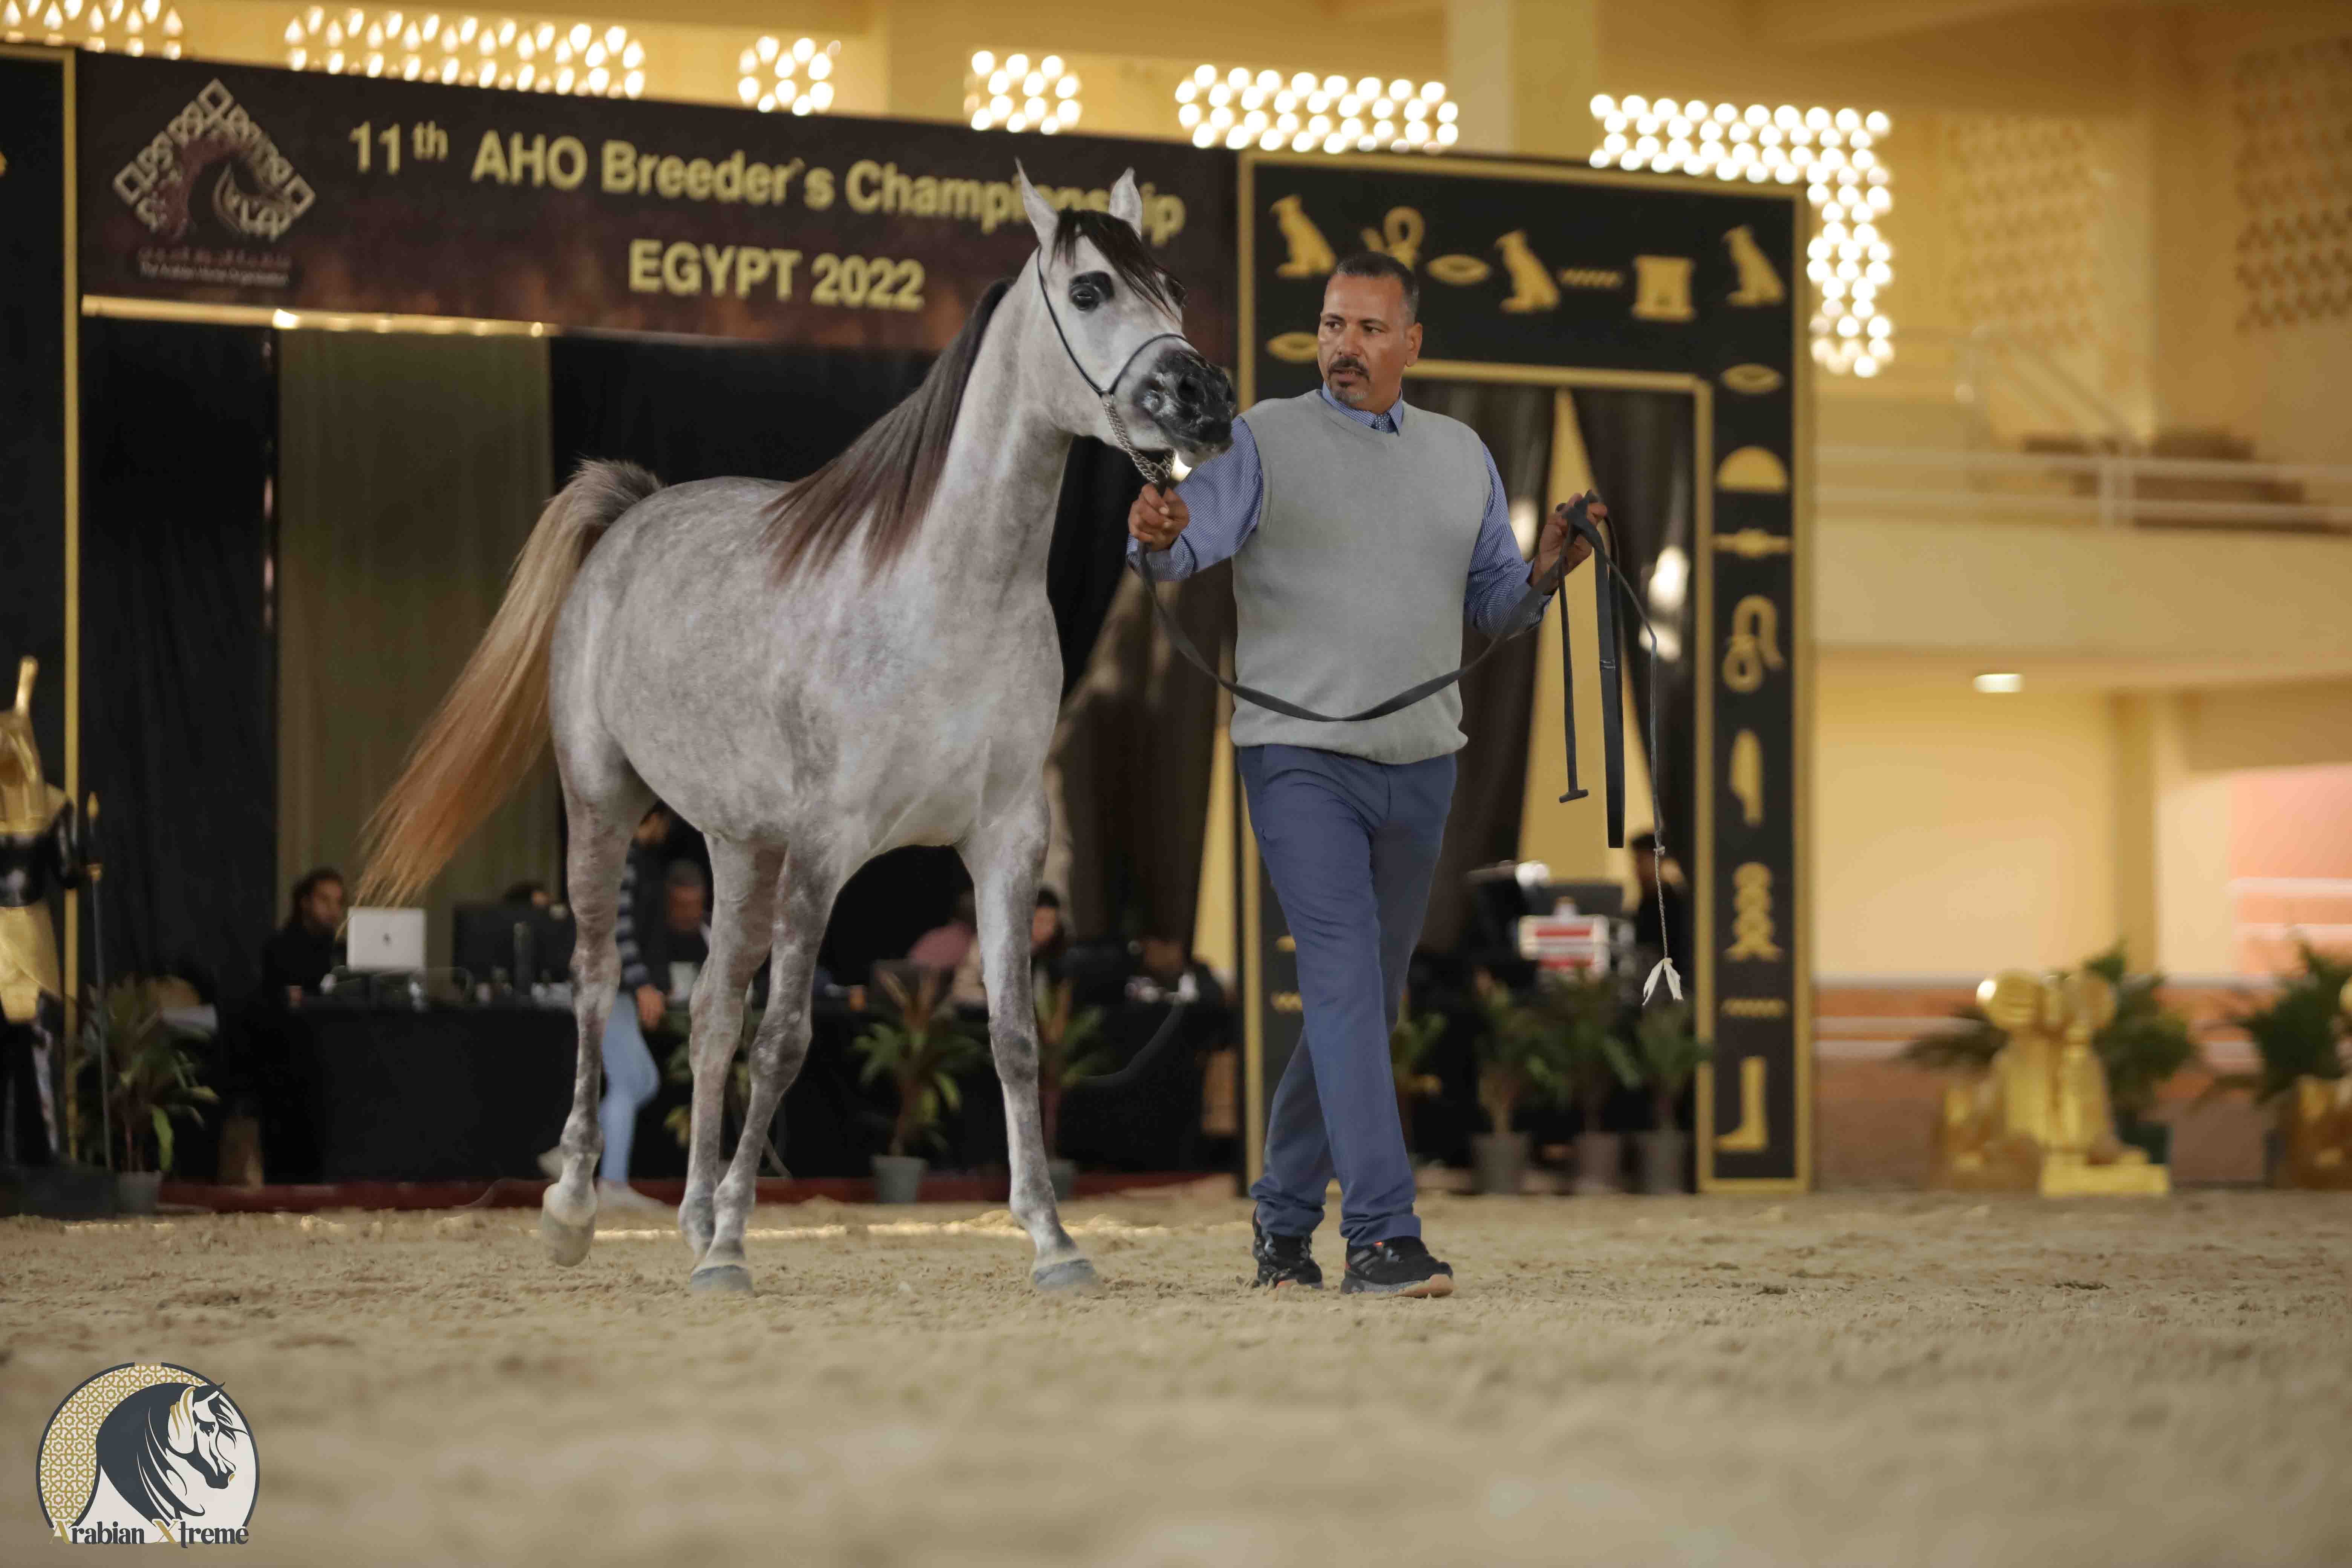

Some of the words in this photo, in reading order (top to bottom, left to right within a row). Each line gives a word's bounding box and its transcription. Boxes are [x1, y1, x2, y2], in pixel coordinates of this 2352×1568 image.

[351, 121, 449, 174] 11th
[472, 130, 588, 190] AHO
[600, 139, 835, 210] Breeder's
[628, 238, 801, 301] EGYPT
[810, 253, 926, 312] 2022
